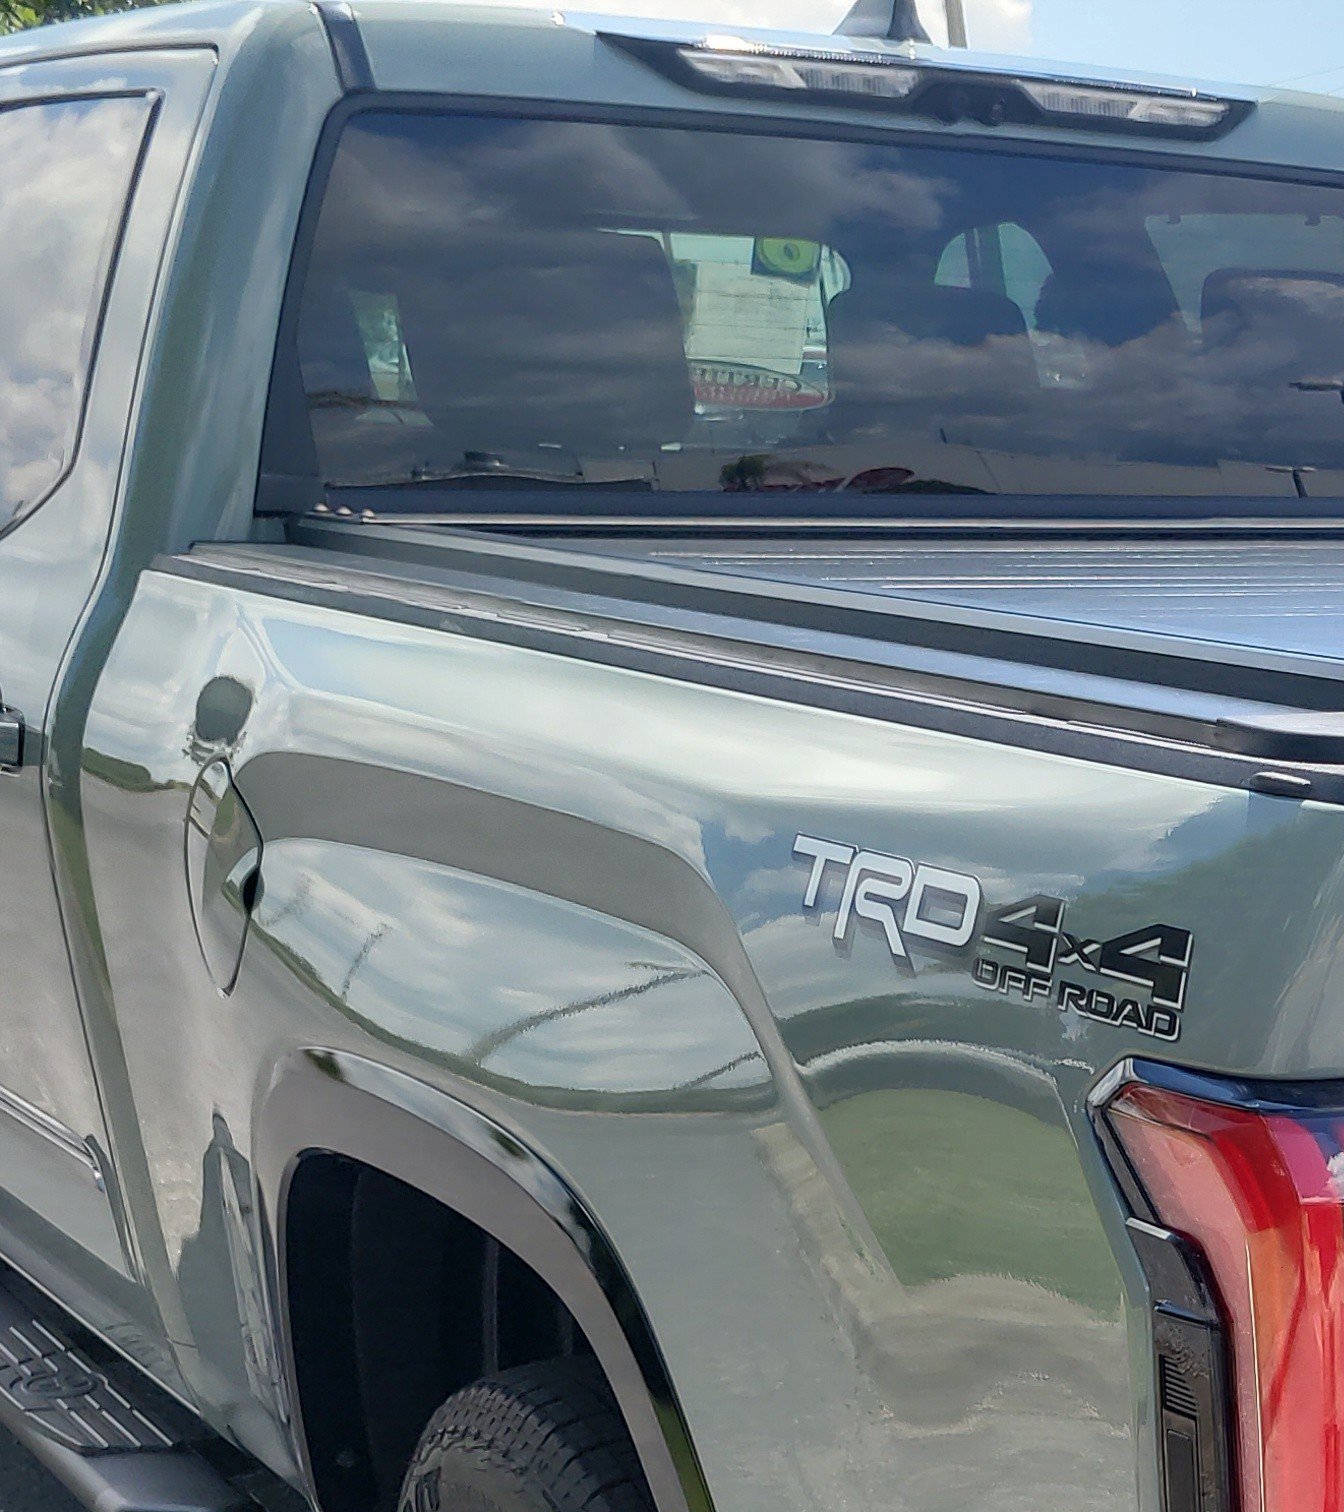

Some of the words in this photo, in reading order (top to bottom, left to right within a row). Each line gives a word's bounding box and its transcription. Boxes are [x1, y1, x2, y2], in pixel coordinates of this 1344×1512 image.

[793, 833, 981, 958] TRD
[971, 957, 1052, 1002] OFF
[1057, 980, 1182, 1042] ROAD
